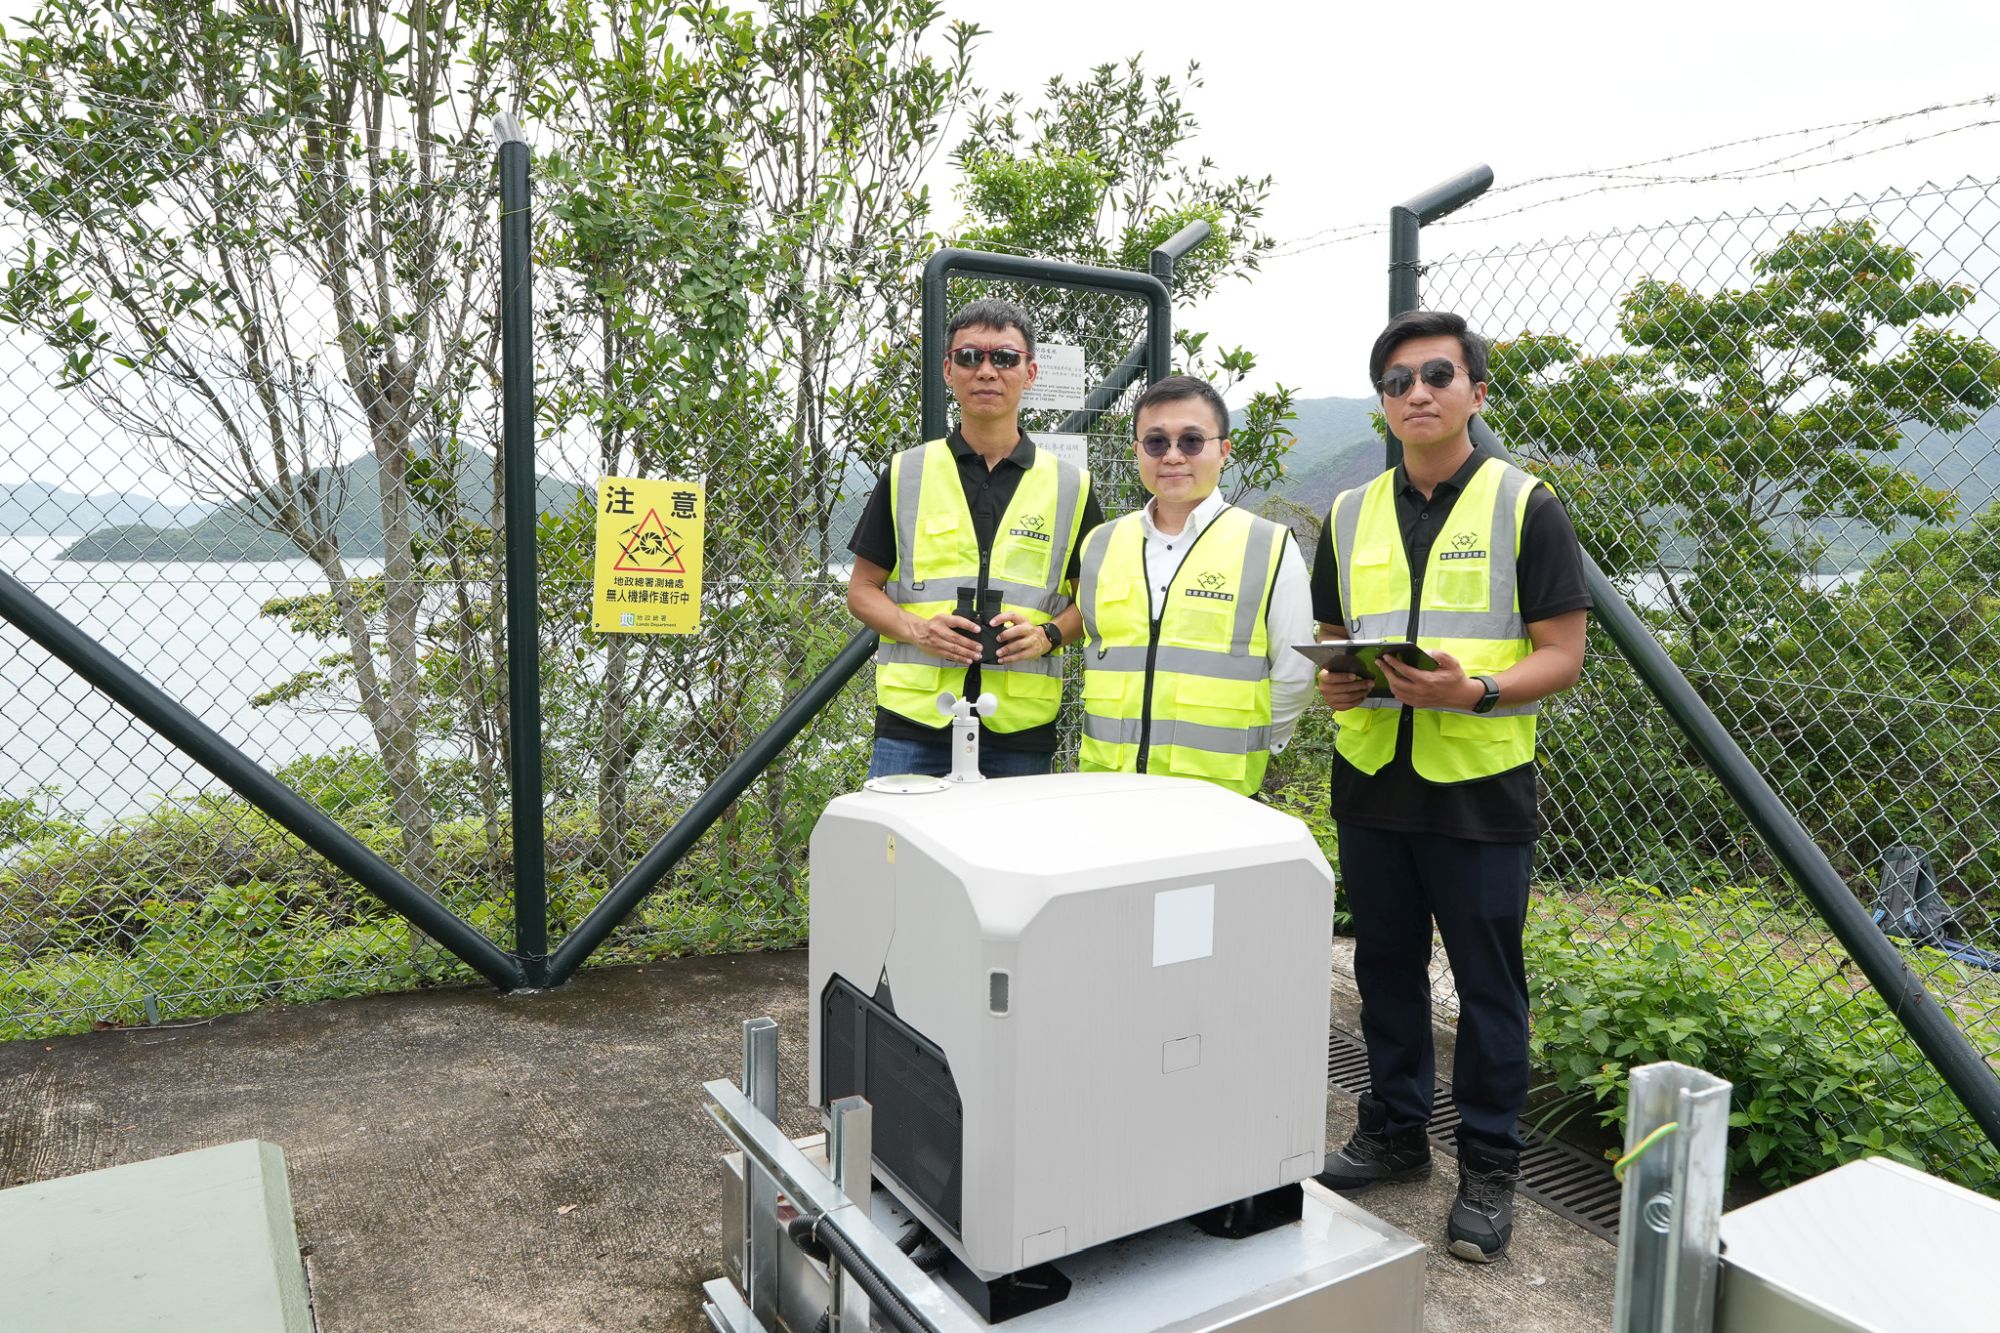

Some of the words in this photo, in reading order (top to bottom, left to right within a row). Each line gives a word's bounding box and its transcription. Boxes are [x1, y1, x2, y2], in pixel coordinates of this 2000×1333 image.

[606, 486, 634, 514] 注
[671, 491, 697, 519] 意
[614, 576, 685, 589] 地政總署測繪處
[606, 589, 689, 605] 無人機操作進行中
